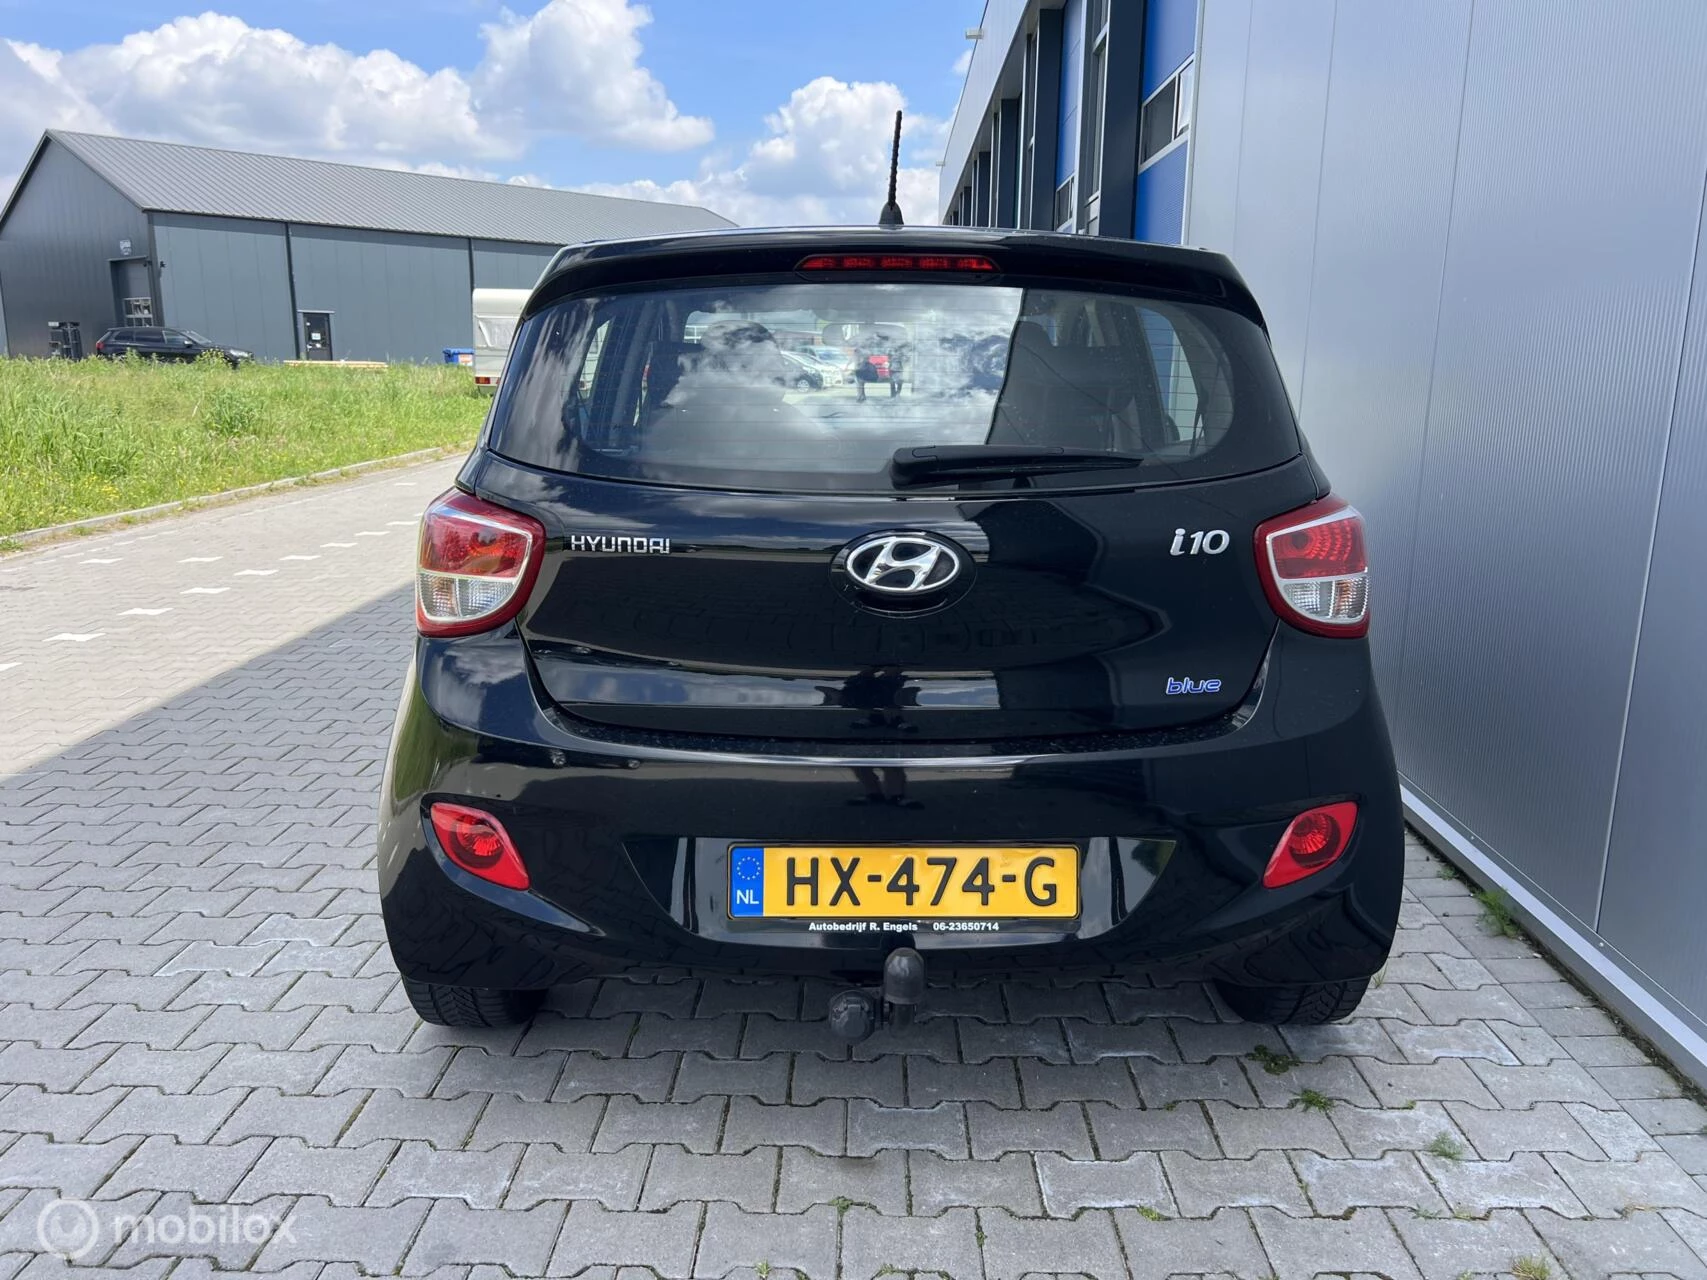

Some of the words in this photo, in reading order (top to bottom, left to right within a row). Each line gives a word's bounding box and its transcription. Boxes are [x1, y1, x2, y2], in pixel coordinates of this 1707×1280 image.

[570, 534, 670, 554] HYUNDAI
[1169, 528, 1230, 556] i10
[1166, 677, 1221, 695] blue
[785, 856, 1058, 907] HX-474-G
[736, 889, 759, 905] NL
[808, 922, 866, 932] Autobedrijf
[869, 922, 880, 931] R.
[883, 922, 918, 933] Engels
[933, 922, 999, 931] 06-23650714
